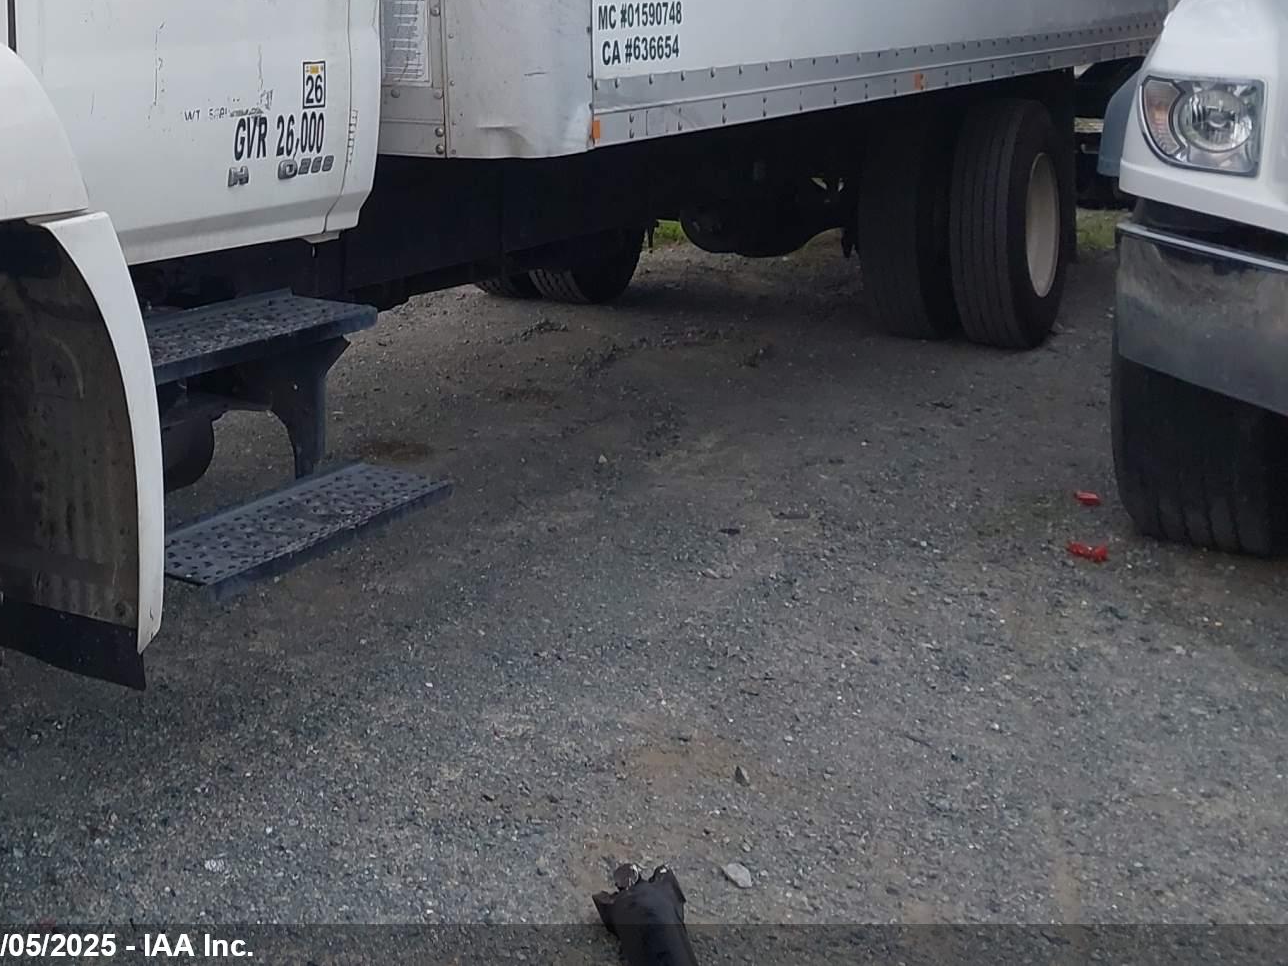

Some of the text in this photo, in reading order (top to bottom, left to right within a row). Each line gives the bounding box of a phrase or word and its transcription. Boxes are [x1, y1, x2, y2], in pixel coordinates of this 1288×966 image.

[598, 1, 682, 31] MC #01590748
[602, 34, 680, 66] CA #636654
[305, 74, 323, 104] 26
[234, 111, 325, 161] GVR 26,000
